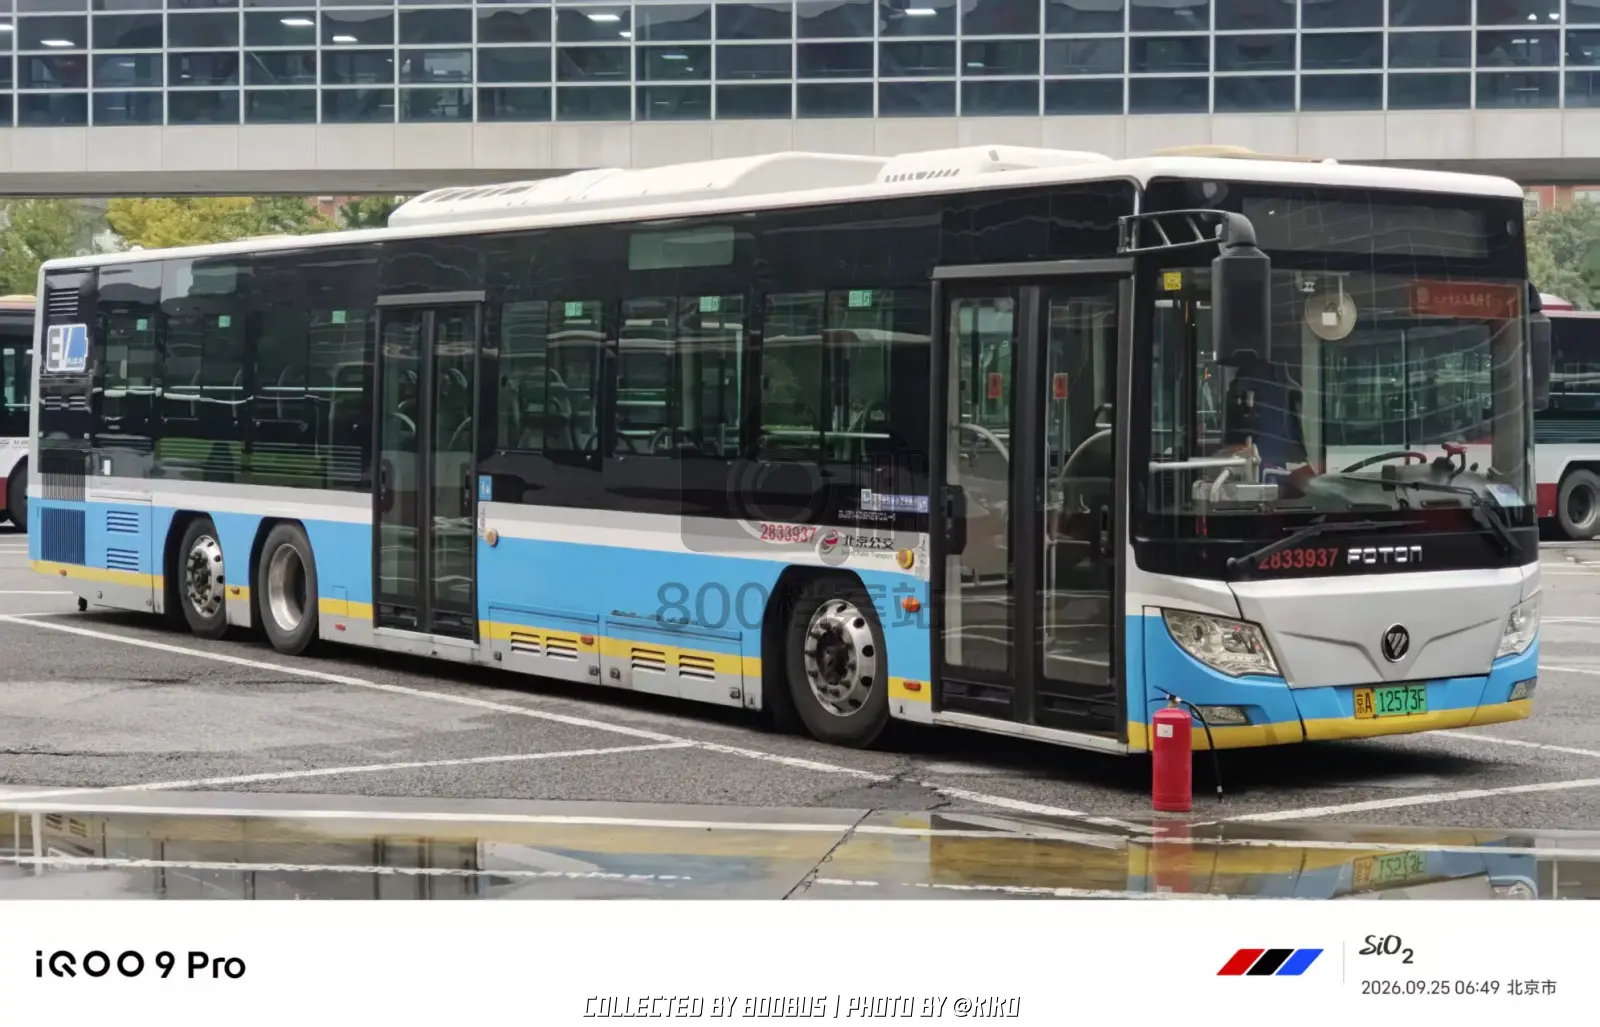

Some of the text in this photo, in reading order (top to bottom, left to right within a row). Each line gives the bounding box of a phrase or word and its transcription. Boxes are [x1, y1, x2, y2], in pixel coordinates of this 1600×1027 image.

[760, 523, 817, 543] 2833937
[842, 535, 895, 550] 北京公交
[1258, 548, 1338, 570] 2833937
[1347, 546, 1423, 564] FOTON
